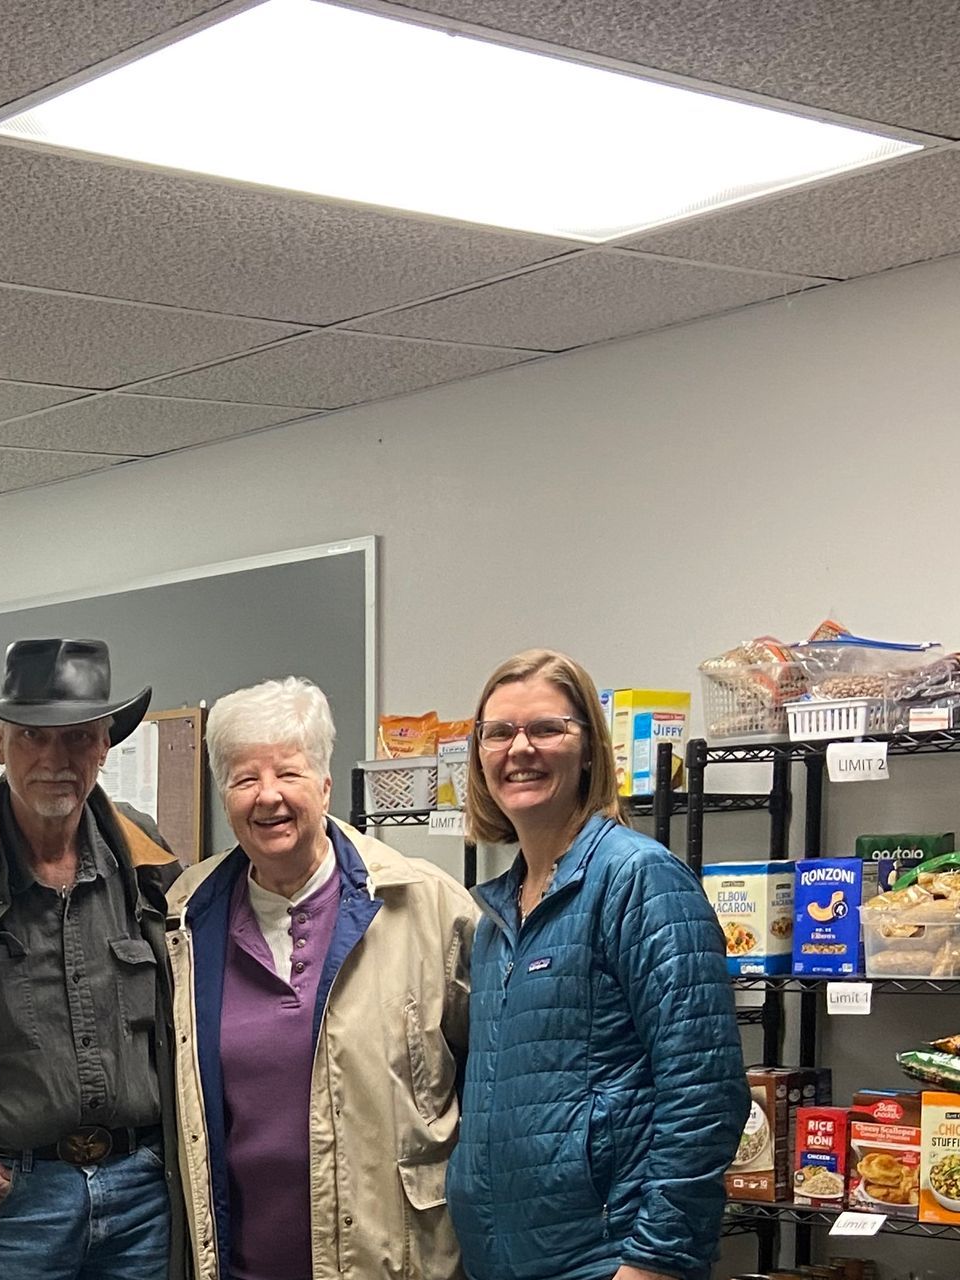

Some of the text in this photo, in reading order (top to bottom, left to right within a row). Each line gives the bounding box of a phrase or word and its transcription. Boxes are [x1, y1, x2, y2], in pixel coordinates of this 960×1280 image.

[653, 723, 683, 737] JIFFY
[839, 758, 886, 771] LIMIT 2
[430, 818, 456, 828] LIMIT
[801, 868, 855, 886] RONZONI
[717, 891, 748, 902] ELBOW
[830, 992, 869, 1004] Limit 1
[807, 1120, 835, 1132] RICE
[807, 1135, 833, 1147] RONI
[836, 1220, 867, 1229] Limit
